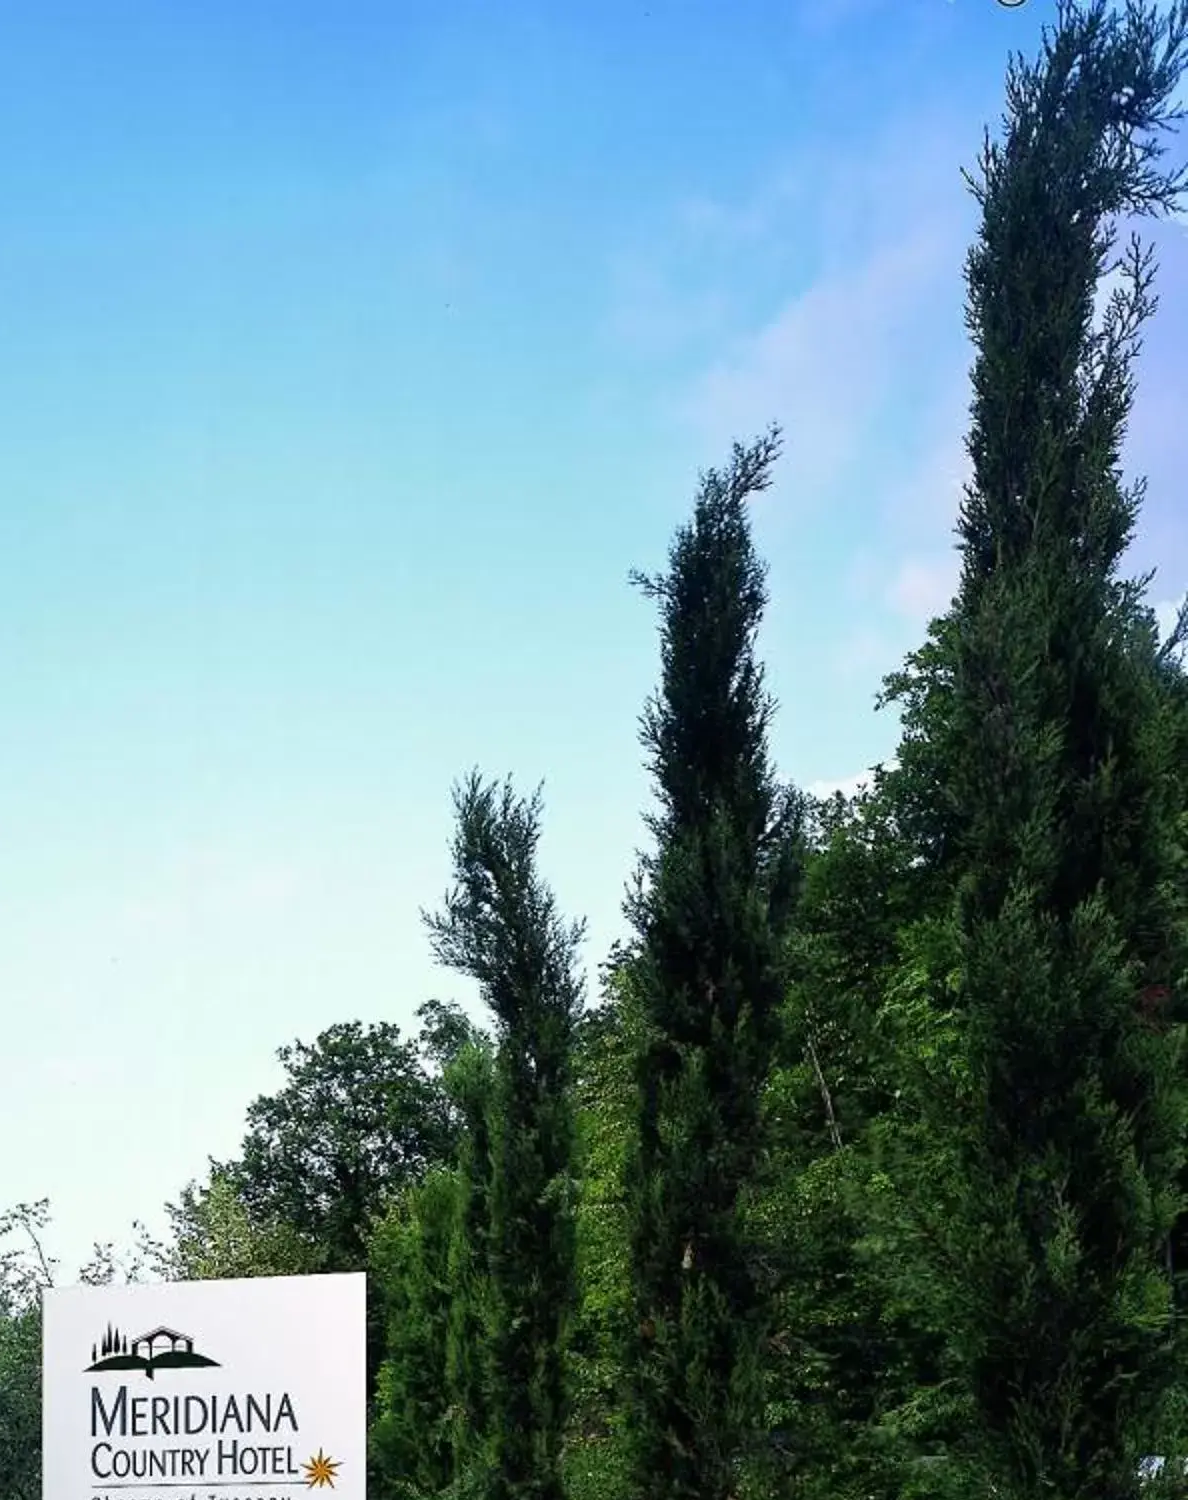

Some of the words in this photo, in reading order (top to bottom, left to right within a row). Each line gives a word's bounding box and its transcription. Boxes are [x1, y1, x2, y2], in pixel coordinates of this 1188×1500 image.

[91, 1385, 299, 1437] MERIDIANA
[91, 1441, 210, 1479] COUNTRY
[217, 1439, 299, 1476] HOTEL
